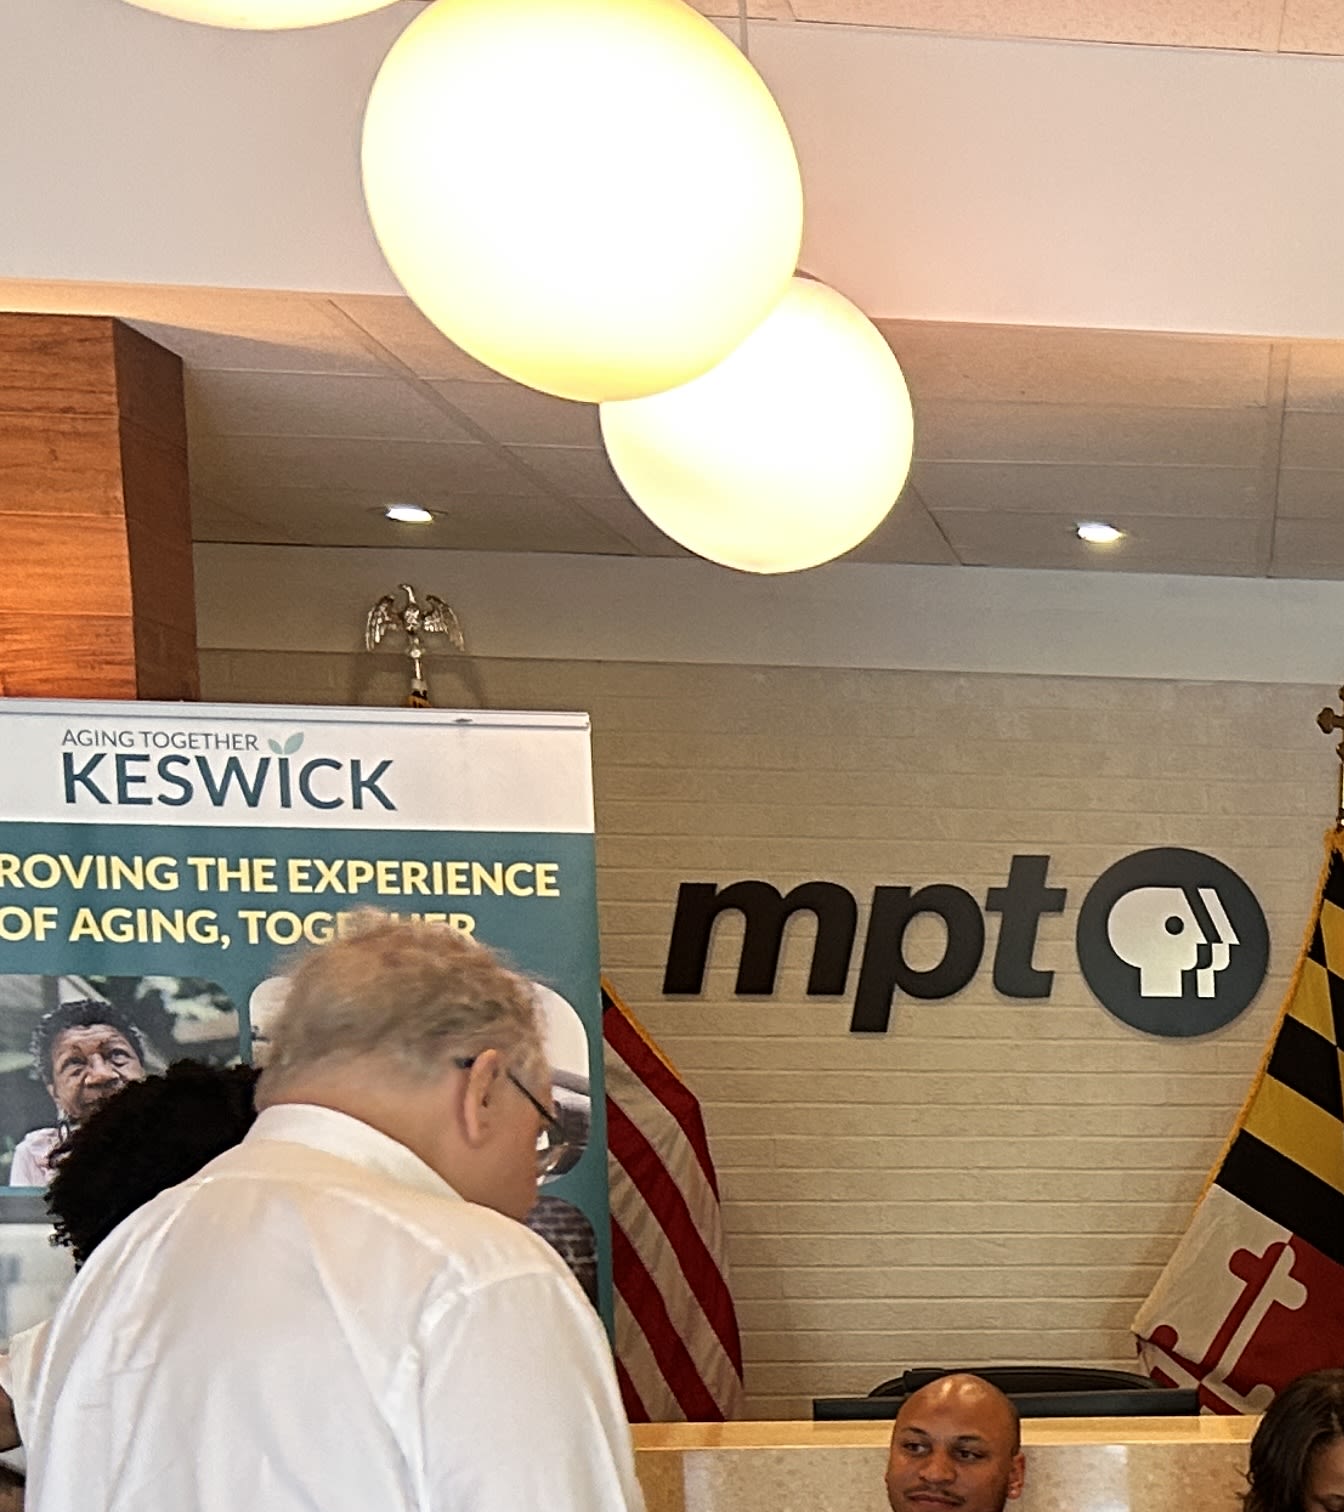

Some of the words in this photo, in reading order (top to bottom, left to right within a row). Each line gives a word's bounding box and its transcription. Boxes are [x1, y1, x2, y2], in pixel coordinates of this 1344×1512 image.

[62, 729, 135, 748] AGING
[141, 731, 259, 751] TOGETHER
[62, 751, 398, 812] KESWICK
[187, 855, 279, 893] THE
[287, 858, 561, 897] EXPERIENCE
[0, 905, 59, 942] OF
[69, 906, 232, 950] AGING,
[662, 854, 1068, 1033] mpt
